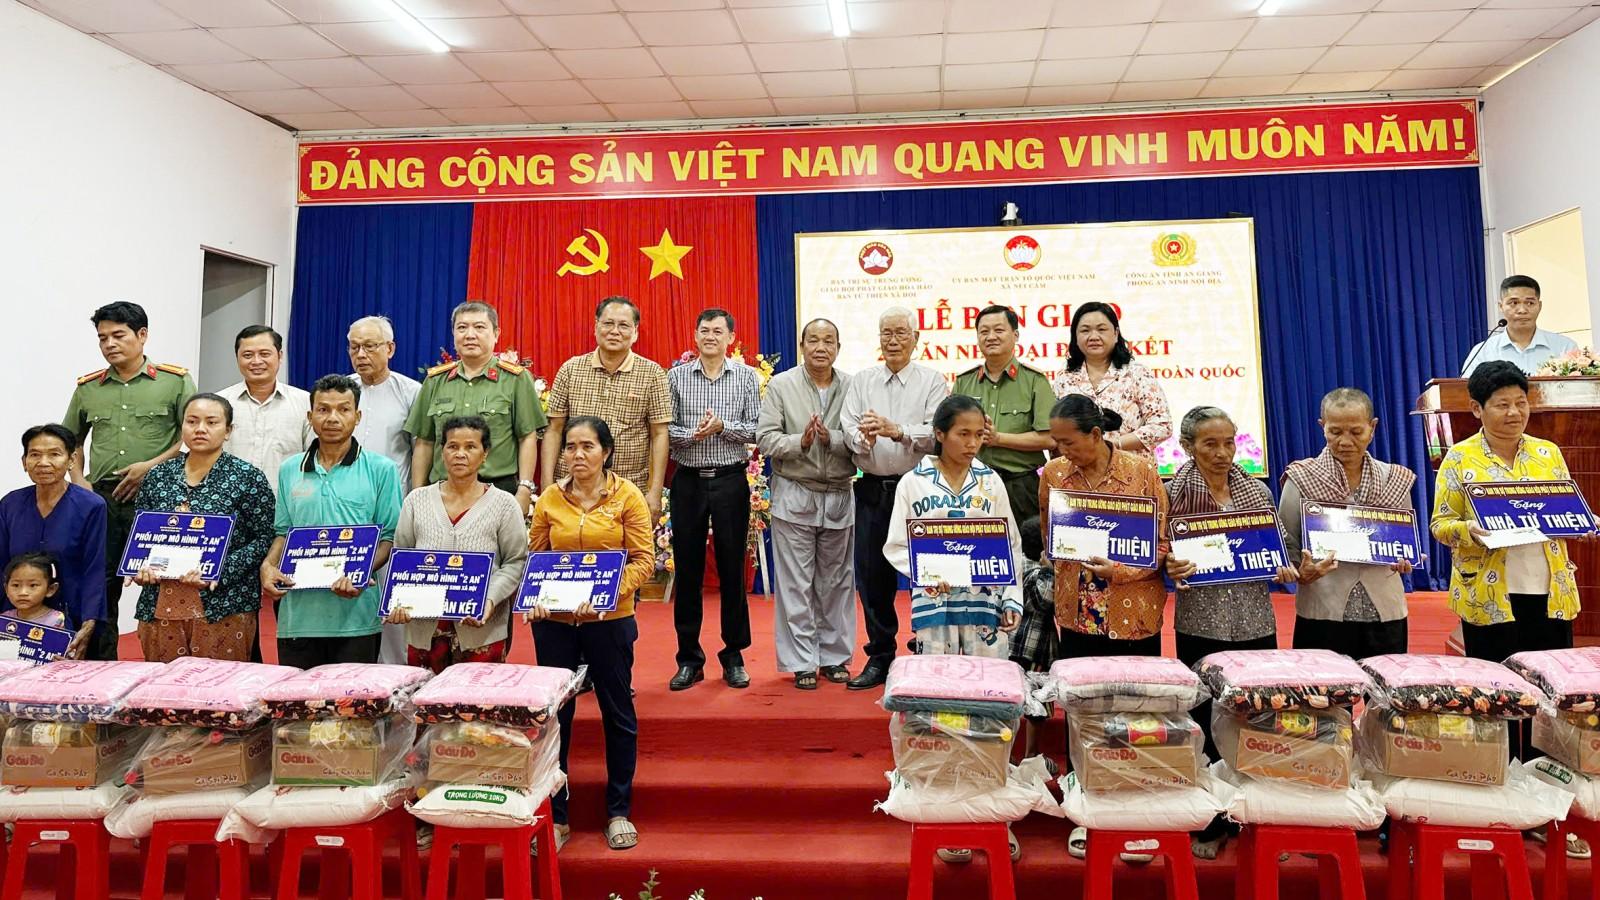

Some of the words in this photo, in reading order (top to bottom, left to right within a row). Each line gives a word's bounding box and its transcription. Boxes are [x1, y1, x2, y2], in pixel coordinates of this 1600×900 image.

[309, 148, 425, 190] ĐẢNG
[439, 147, 555, 194] CỘNG
[569, 140, 653, 184] SẢN
[668, 141, 765, 187] VIỆT
[782, 144, 877, 178] NAM
[893, 138, 1045, 180] QUANG
[1058, 131, 1168, 168] VINH
[1187, 117, 1325, 162] MUÔN
[917, 299, 953, 331] LỄ
[1128, 335, 1173, 355] KẾT
[1151, 367, 1195, 379] TOÀN
[1200, 364, 1246, 379] QUỐC
[1509, 499, 1547, 511] Tặng
[1085, 515, 1120, 532] Tặng
[1483, 512, 1517, 530] NHÀ
[1518, 511, 1541, 528] TỪ
[1542, 511, 1591, 531] THIỆN
[943, 540, 977, 554] Tặng
[1109, 536, 1151, 561] THIỆN
[1369, 540, 1414, 561] THIỆN
[971, 556, 1009, 579] THIỆN
[1239, 548, 1283, 572] THIỆN
[458, 598, 478, 615] KẾT
[446, 791, 470, 800] TRỌNG
[469, 790, 489, 801] LƯỢNG
[489, 793, 505, 803] 10KG
